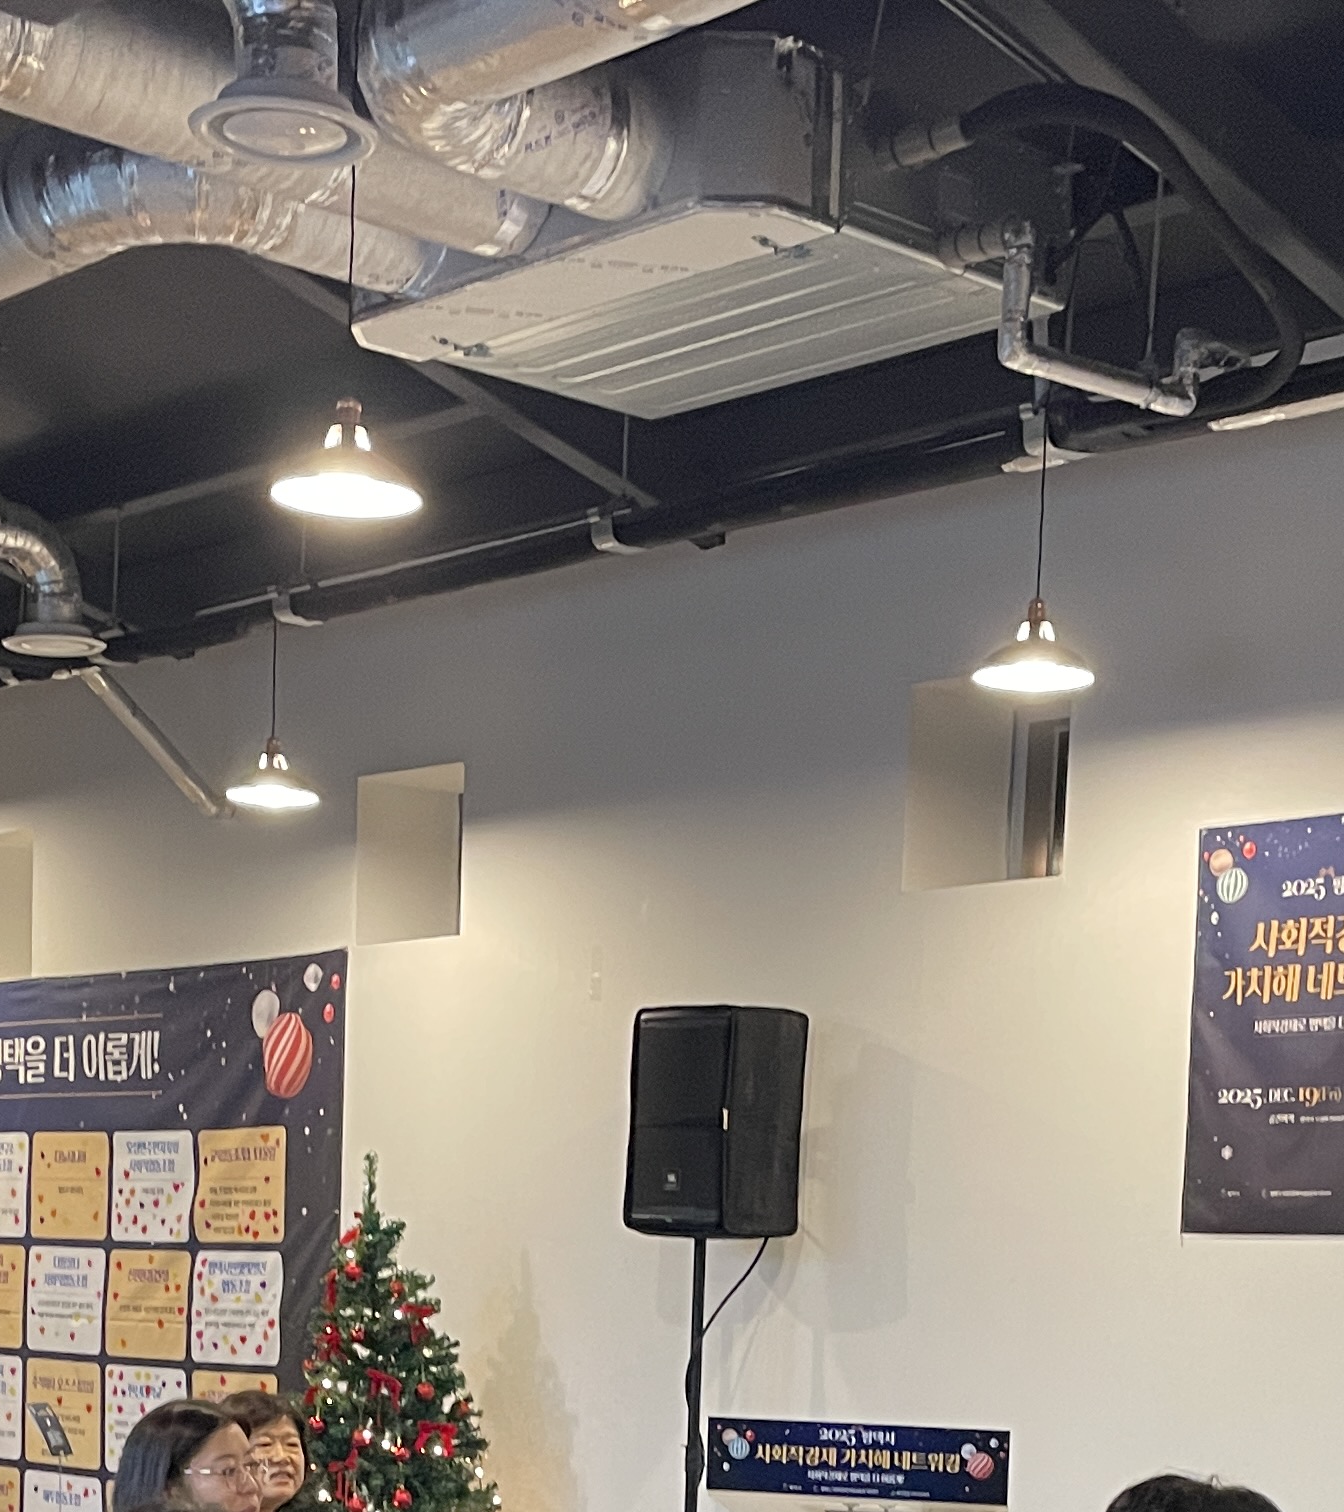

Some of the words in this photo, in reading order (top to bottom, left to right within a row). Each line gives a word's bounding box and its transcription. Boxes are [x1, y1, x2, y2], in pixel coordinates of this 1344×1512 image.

[1282, 877, 1326, 901] 2025
[1222, 962, 1302, 1007] 가치해
[53, 1034, 75, 1082] 더
[83, 1030, 160, 1083] 이롭게!
[819, 1427, 856, 1446] 2025
